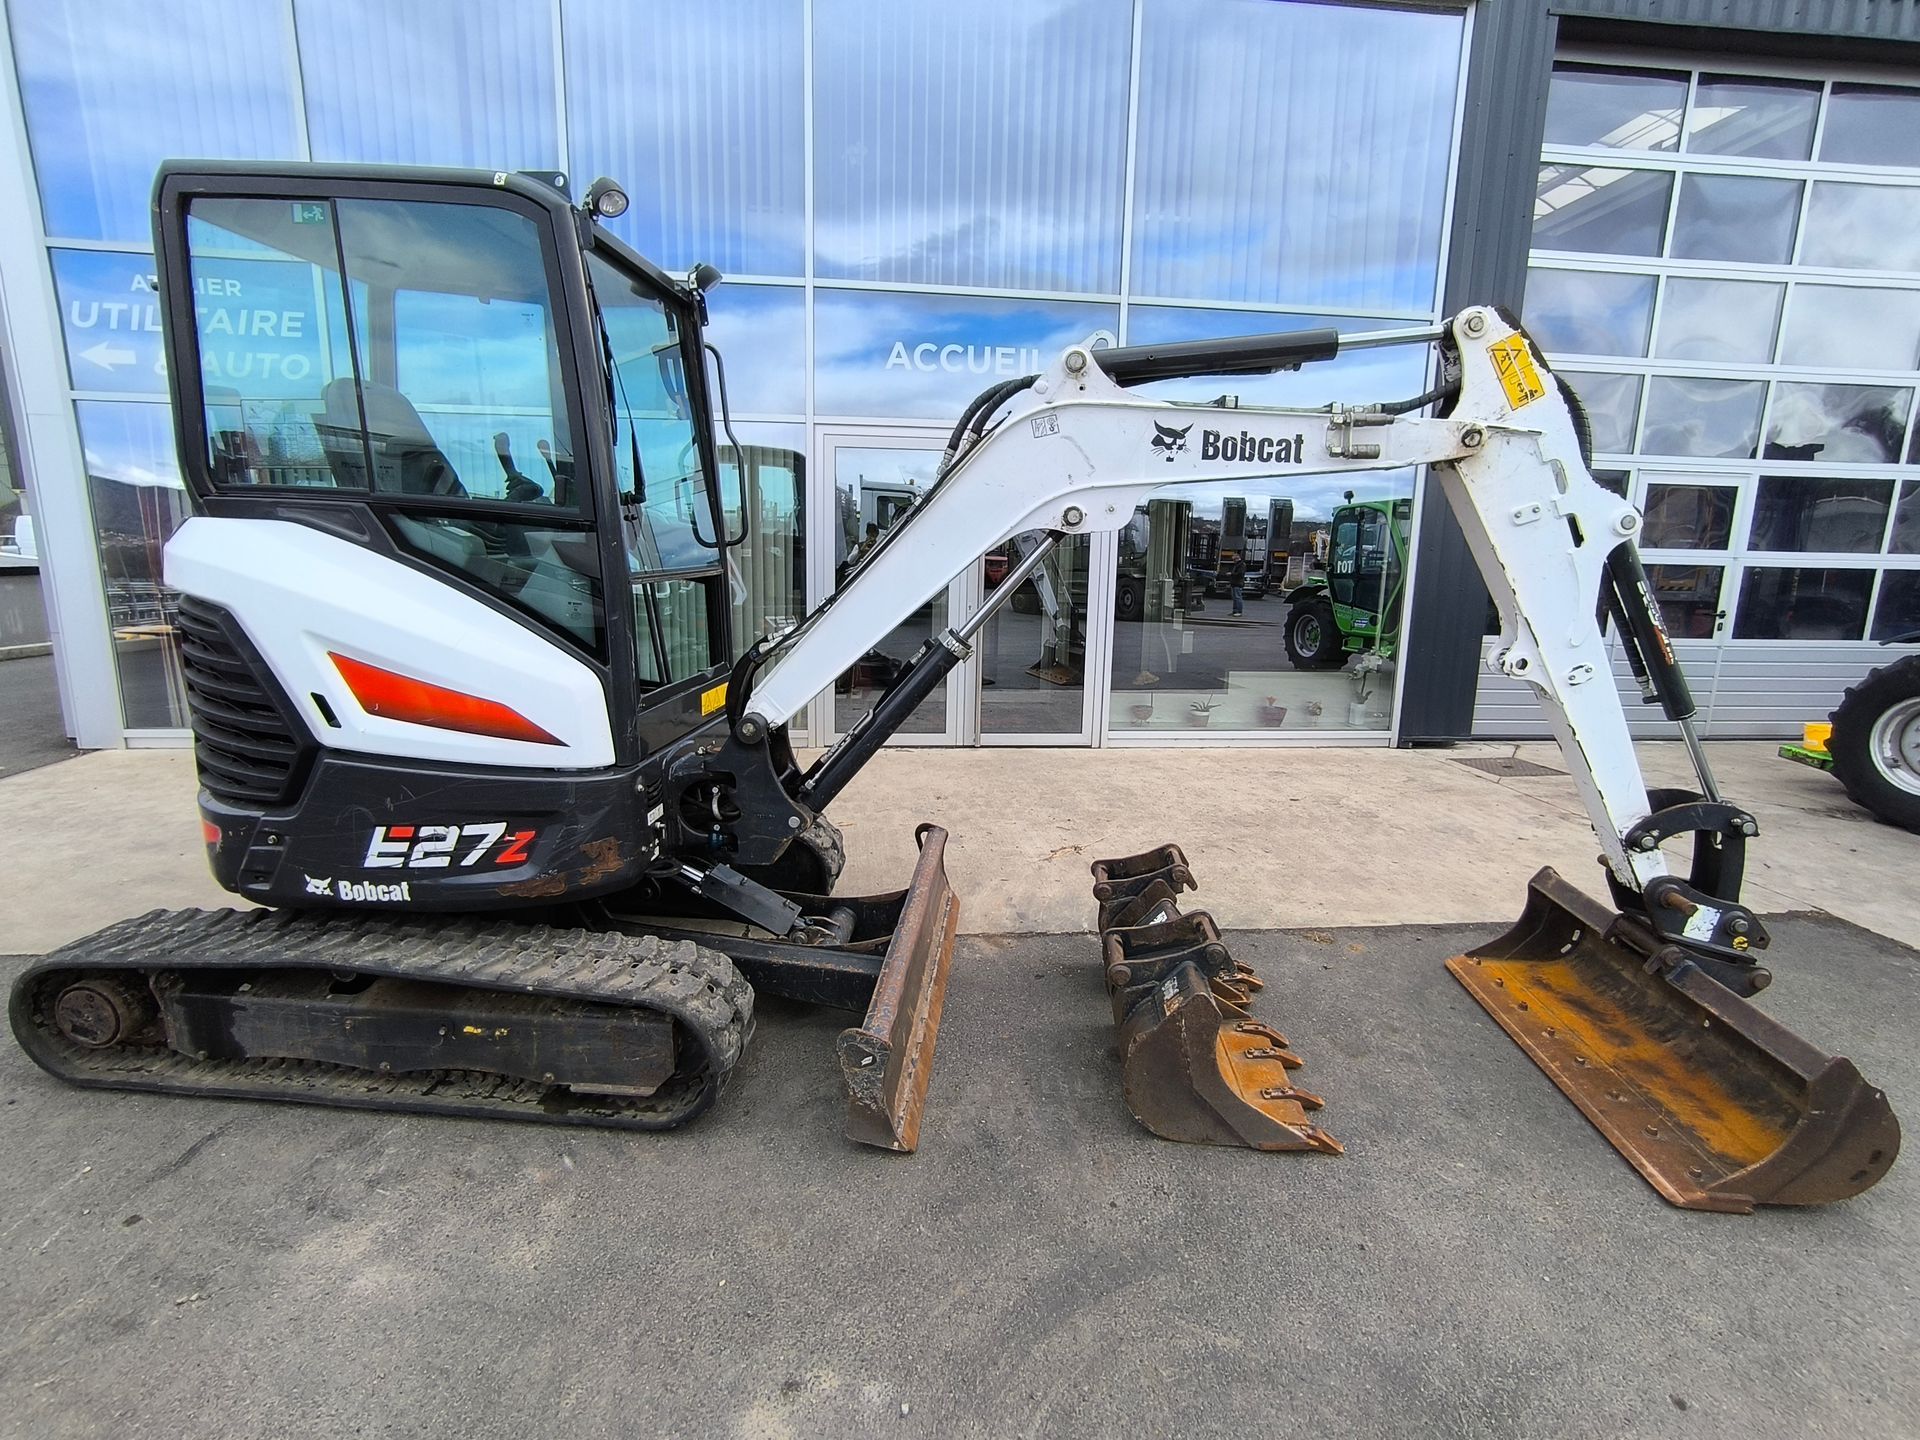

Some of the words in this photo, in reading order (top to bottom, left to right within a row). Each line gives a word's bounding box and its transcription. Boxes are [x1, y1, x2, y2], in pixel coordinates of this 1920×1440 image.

[130, 273, 242, 297] ATIER
[71, 300, 305, 338] UTILAIRE
[203, 351, 311, 381] AUTO
[885, 341, 1046, 376] ACCUEIL
[1201, 429, 1304, 464] Bobcat
[337, 880, 411, 901] Bobcat
